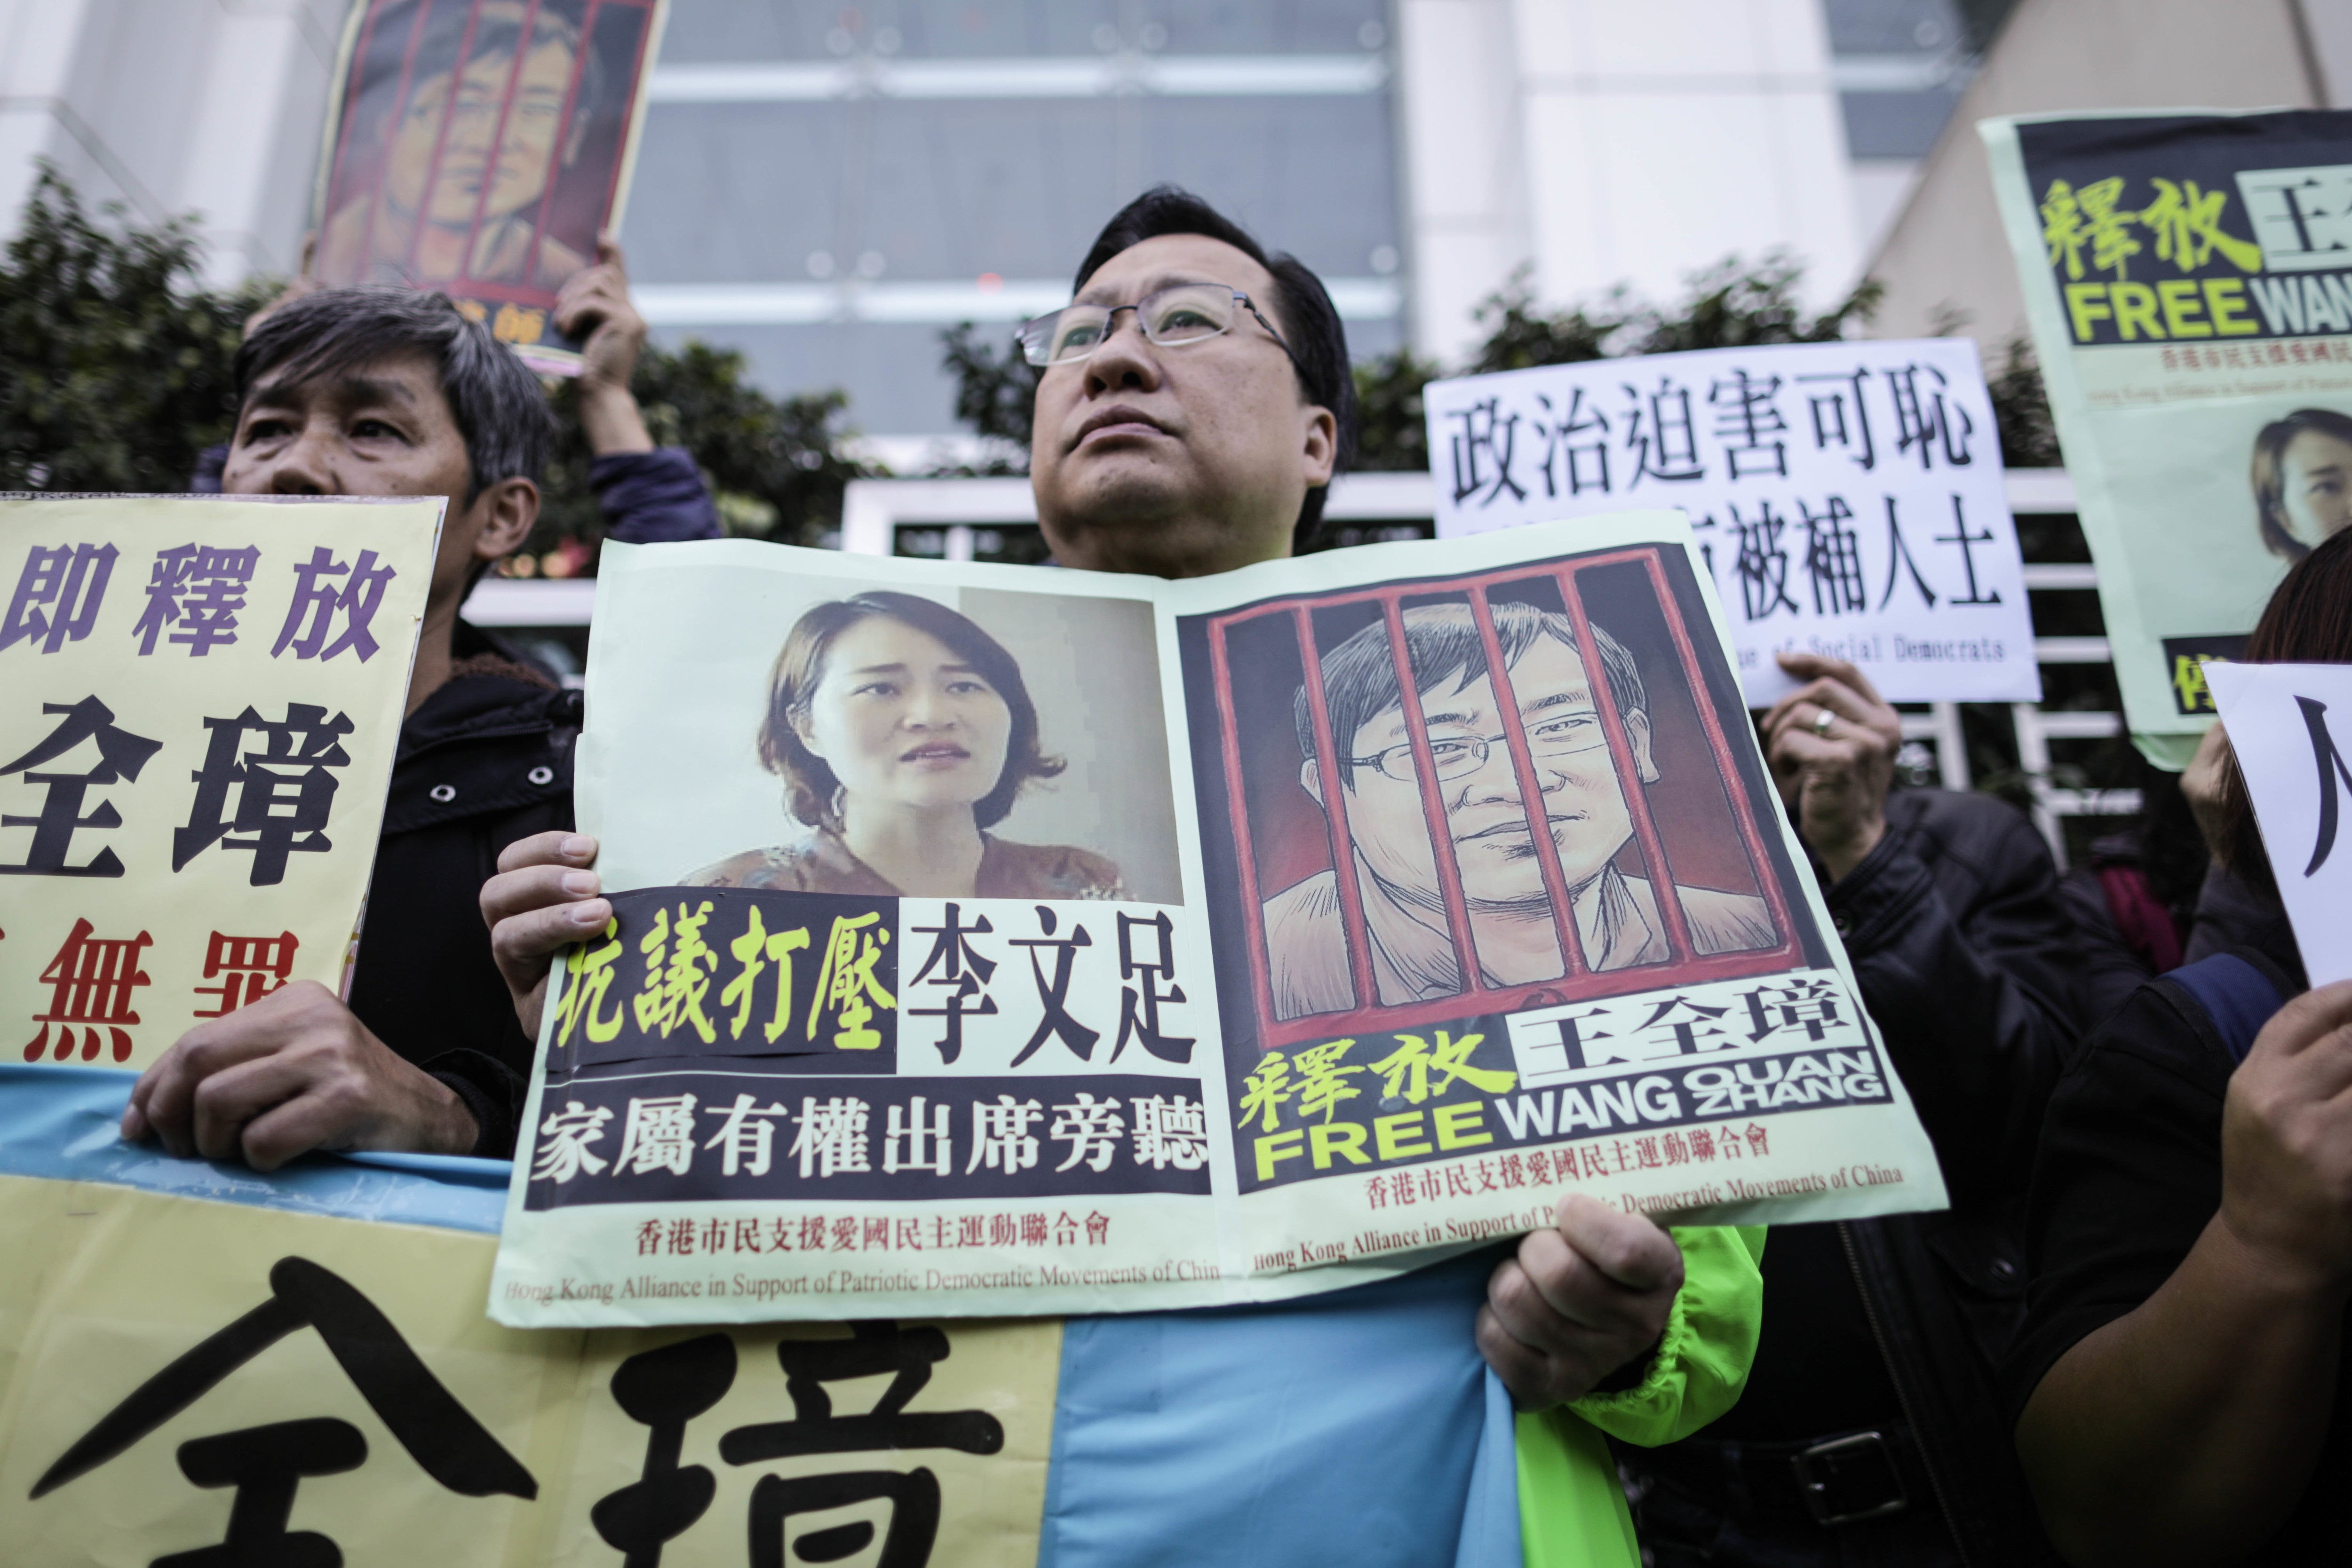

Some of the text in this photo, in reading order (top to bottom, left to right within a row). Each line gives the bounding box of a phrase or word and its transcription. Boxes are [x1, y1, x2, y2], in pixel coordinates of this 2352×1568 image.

[2041, 176, 2352, 281] 釋放 王
[2065, 278, 2259, 342] FREE
[1446, 363, 1973, 508] 政治迫害可恥
[0, 542, 397, 664] 即釋放
[1807, 634, 1881, 661] Social
[1894, 633, 2005, 663] Democrats
[0, 694, 355, 887] 全璋
[0, 918, 299, 1062] 無罪
[554, 901, 1196, 1068] 抗議打壓 李文足
[1238, 979, 1851, 1133] 釋放 王全璋
[1692, 1073, 1885, 1117] ZHANG
[531, 1092, 1209, 1184] 家屬有權出席旁聽
[1254, 1050, 1876, 1181] FREE WANG QUAN
[1364, 1122, 1770, 1210] 香港市民支援愛國民主運動聯合會
[636, 1210, 1110, 1257] 香港市民支援愛國民主運動聯合會
[1299, 1241, 1348, 1262] Kong
[1352, 1228, 1420, 1255] Alliance
[1424, 1222, 1441, 1243] in
[1445, 1212, 1515, 1241] Support
[1522, 1207, 1538, 1229] of
[1622, 1183, 1722, 1214] Democratic
[1725, 1171, 1826, 1201] Movements
[1831, 1167, 1848, 1188] of
[1851, 1164, 1903, 1187] China
[505, 1259, 1220, 1307] Hong Kong Alliance in Support of Patriotic Democratic Movements of Chin
